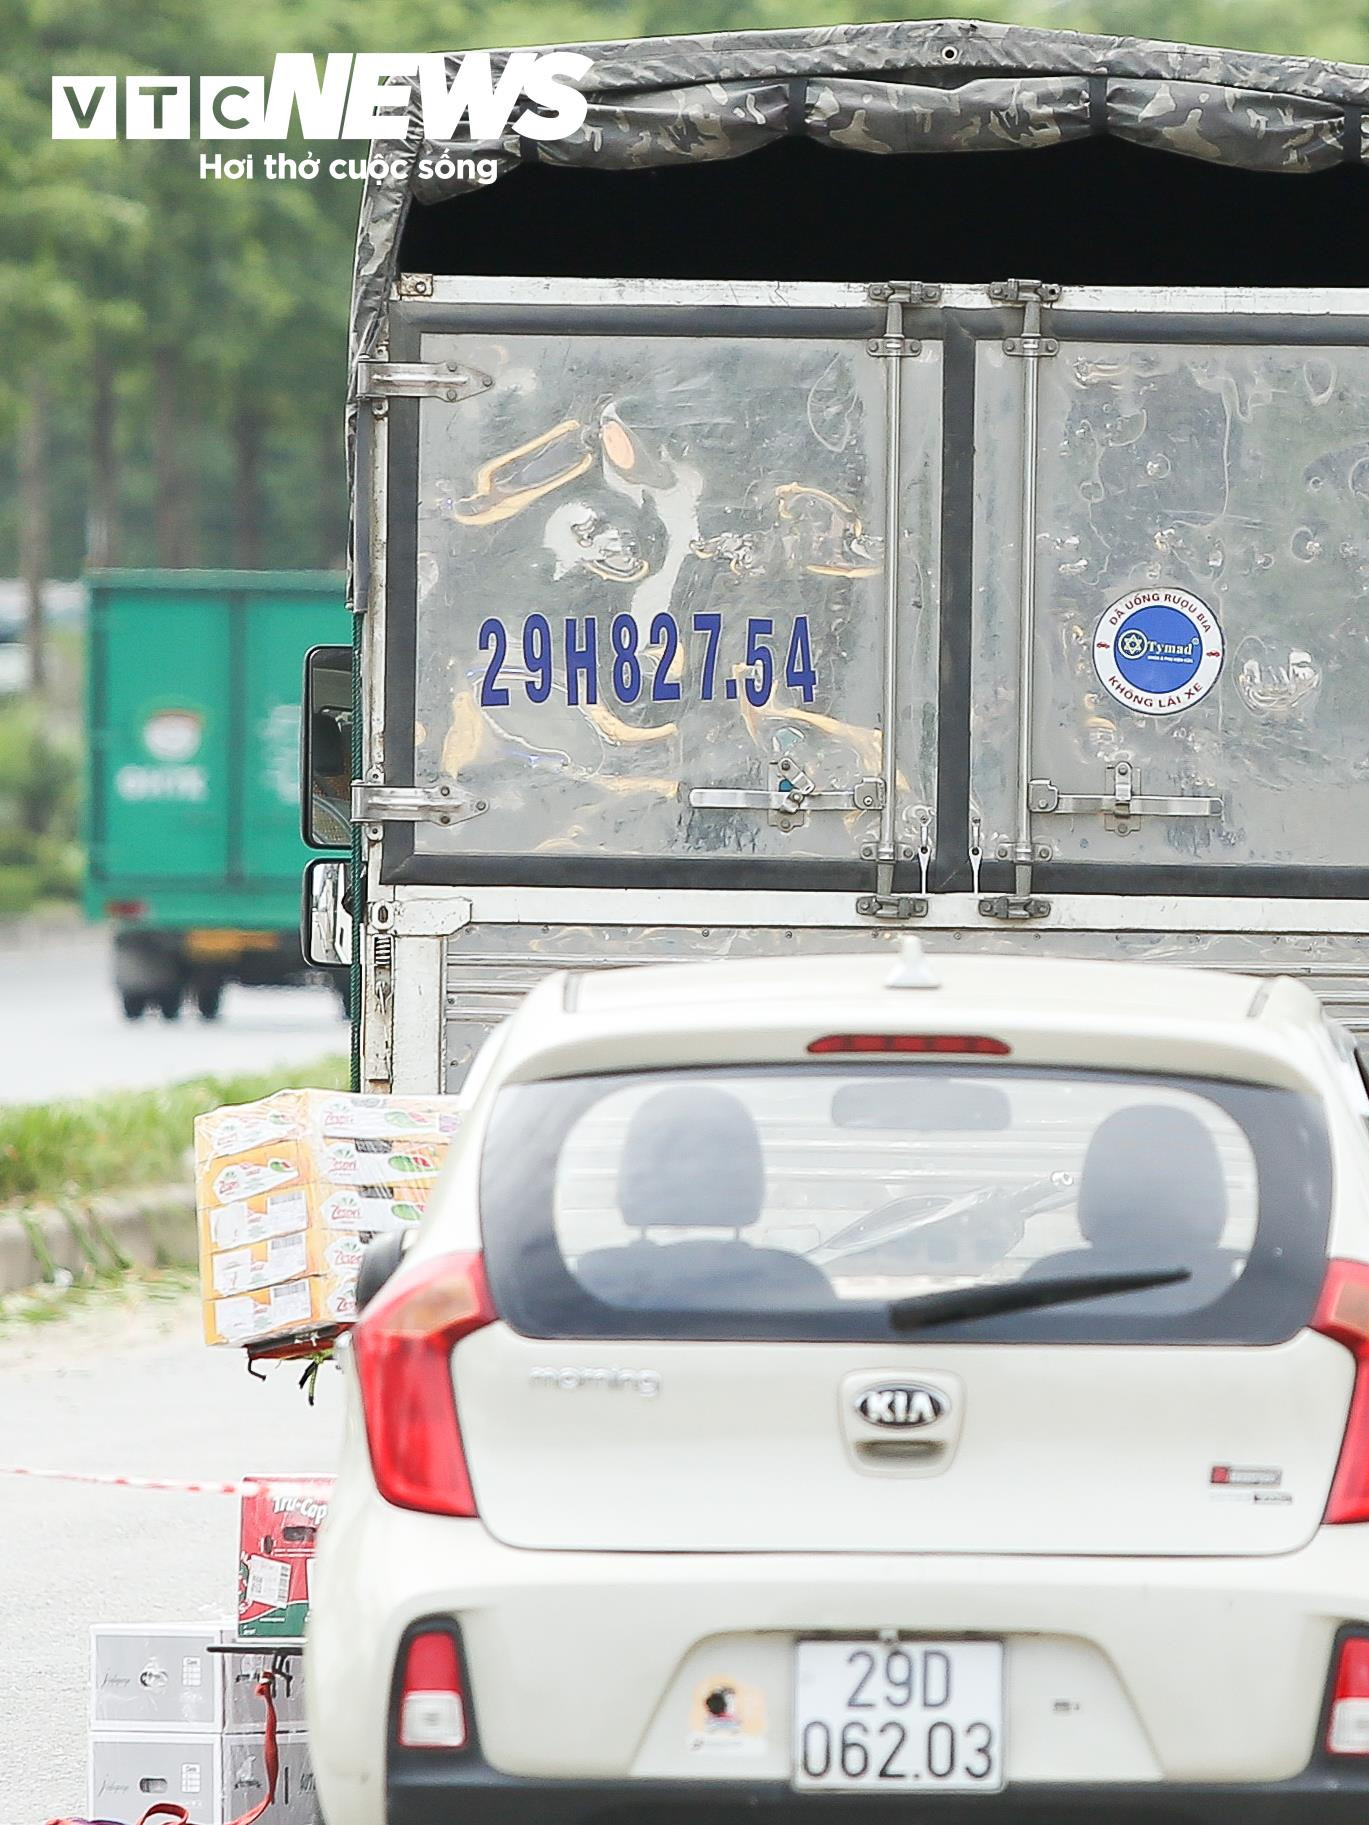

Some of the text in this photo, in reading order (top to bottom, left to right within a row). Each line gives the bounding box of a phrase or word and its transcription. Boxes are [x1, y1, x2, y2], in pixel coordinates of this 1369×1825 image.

[1196, 613, 1212, 633] BIA
[478, 612, 817, 707] 29H827.54
[1148, 639, 1193, 656] Tymad
[1184, 682, 1204, 700] XE
[864, 1390, 938, 1423] KIA
[846, 1650, 951, 1708] 29D
[801, 1720, 993, 1779] 062.03
